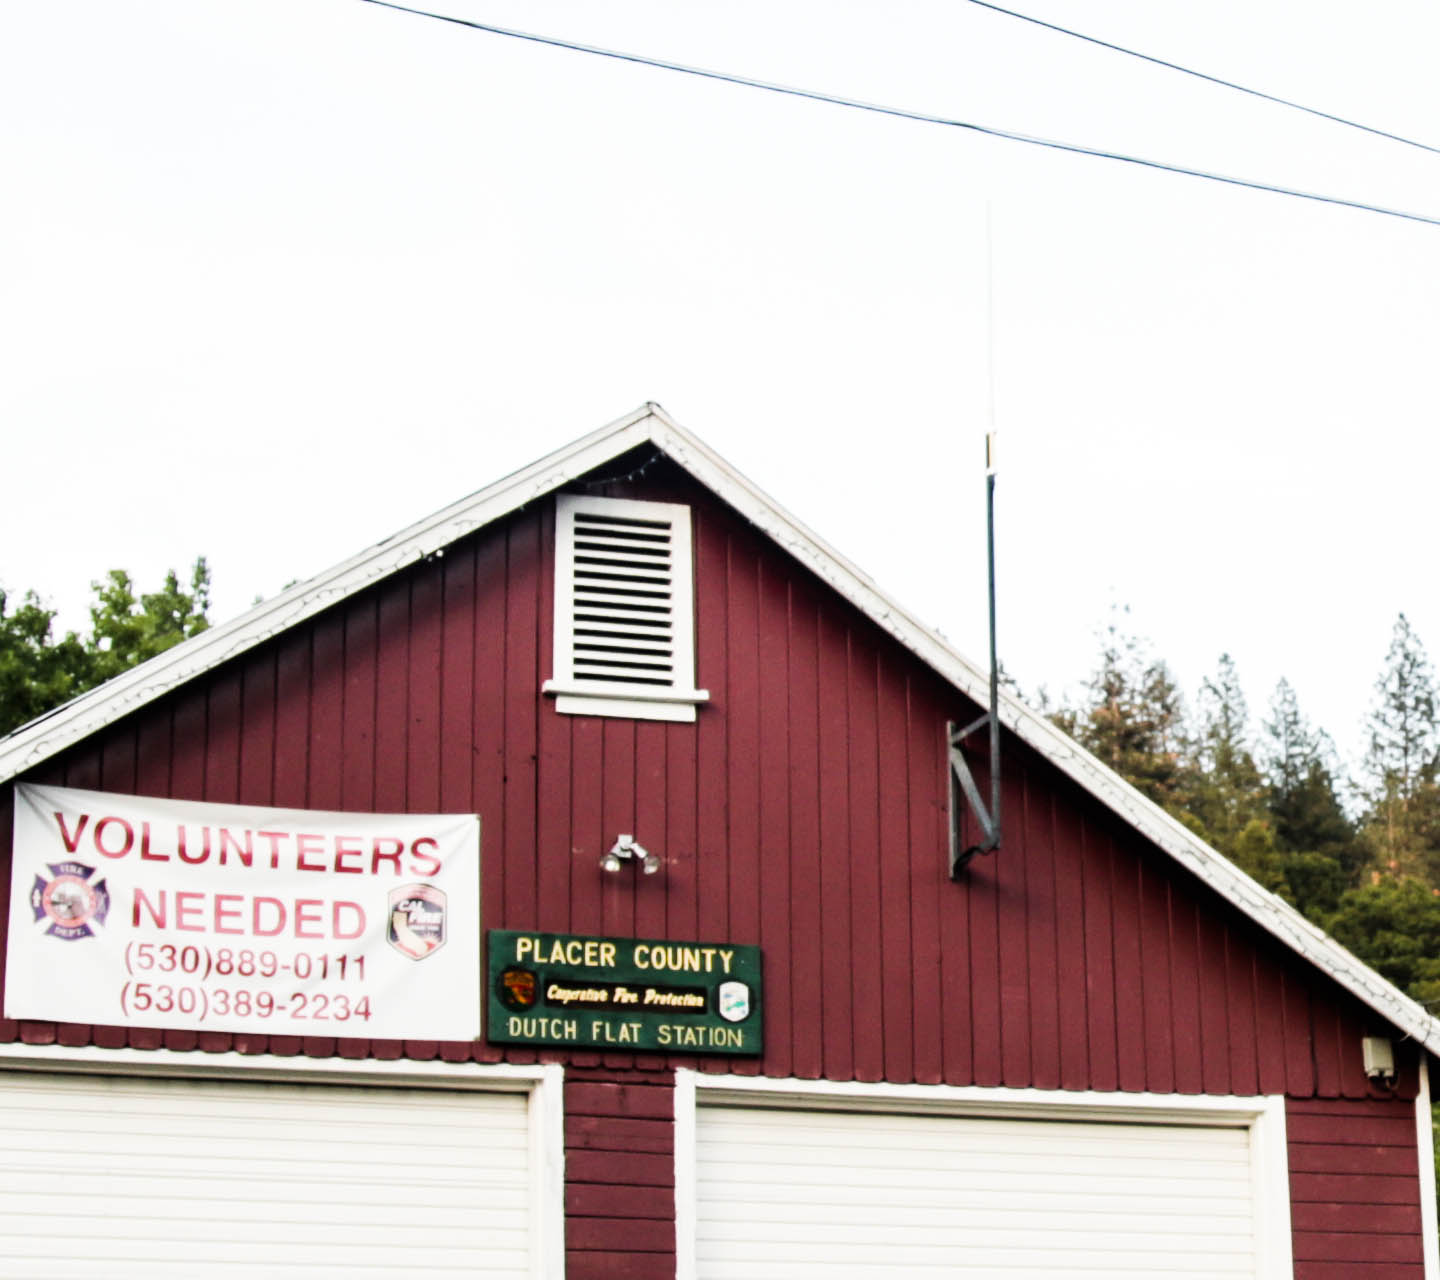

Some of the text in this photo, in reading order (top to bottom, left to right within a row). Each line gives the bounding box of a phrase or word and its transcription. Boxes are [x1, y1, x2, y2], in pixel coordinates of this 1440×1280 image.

[53, 811, 442, 878] VOLUNTEERS
[131, 888, 368, 941] NEEDED
[124, 942, 366, 981] (530)889-0111
[516, 937, 733, 974] PLACER COUNTY
[120, 982, 372, 1022] (530)389-2234
[613, 987, 638, 1004] Fire
[509, 1017, 743, 1047] DUTCH FLAT STATION
